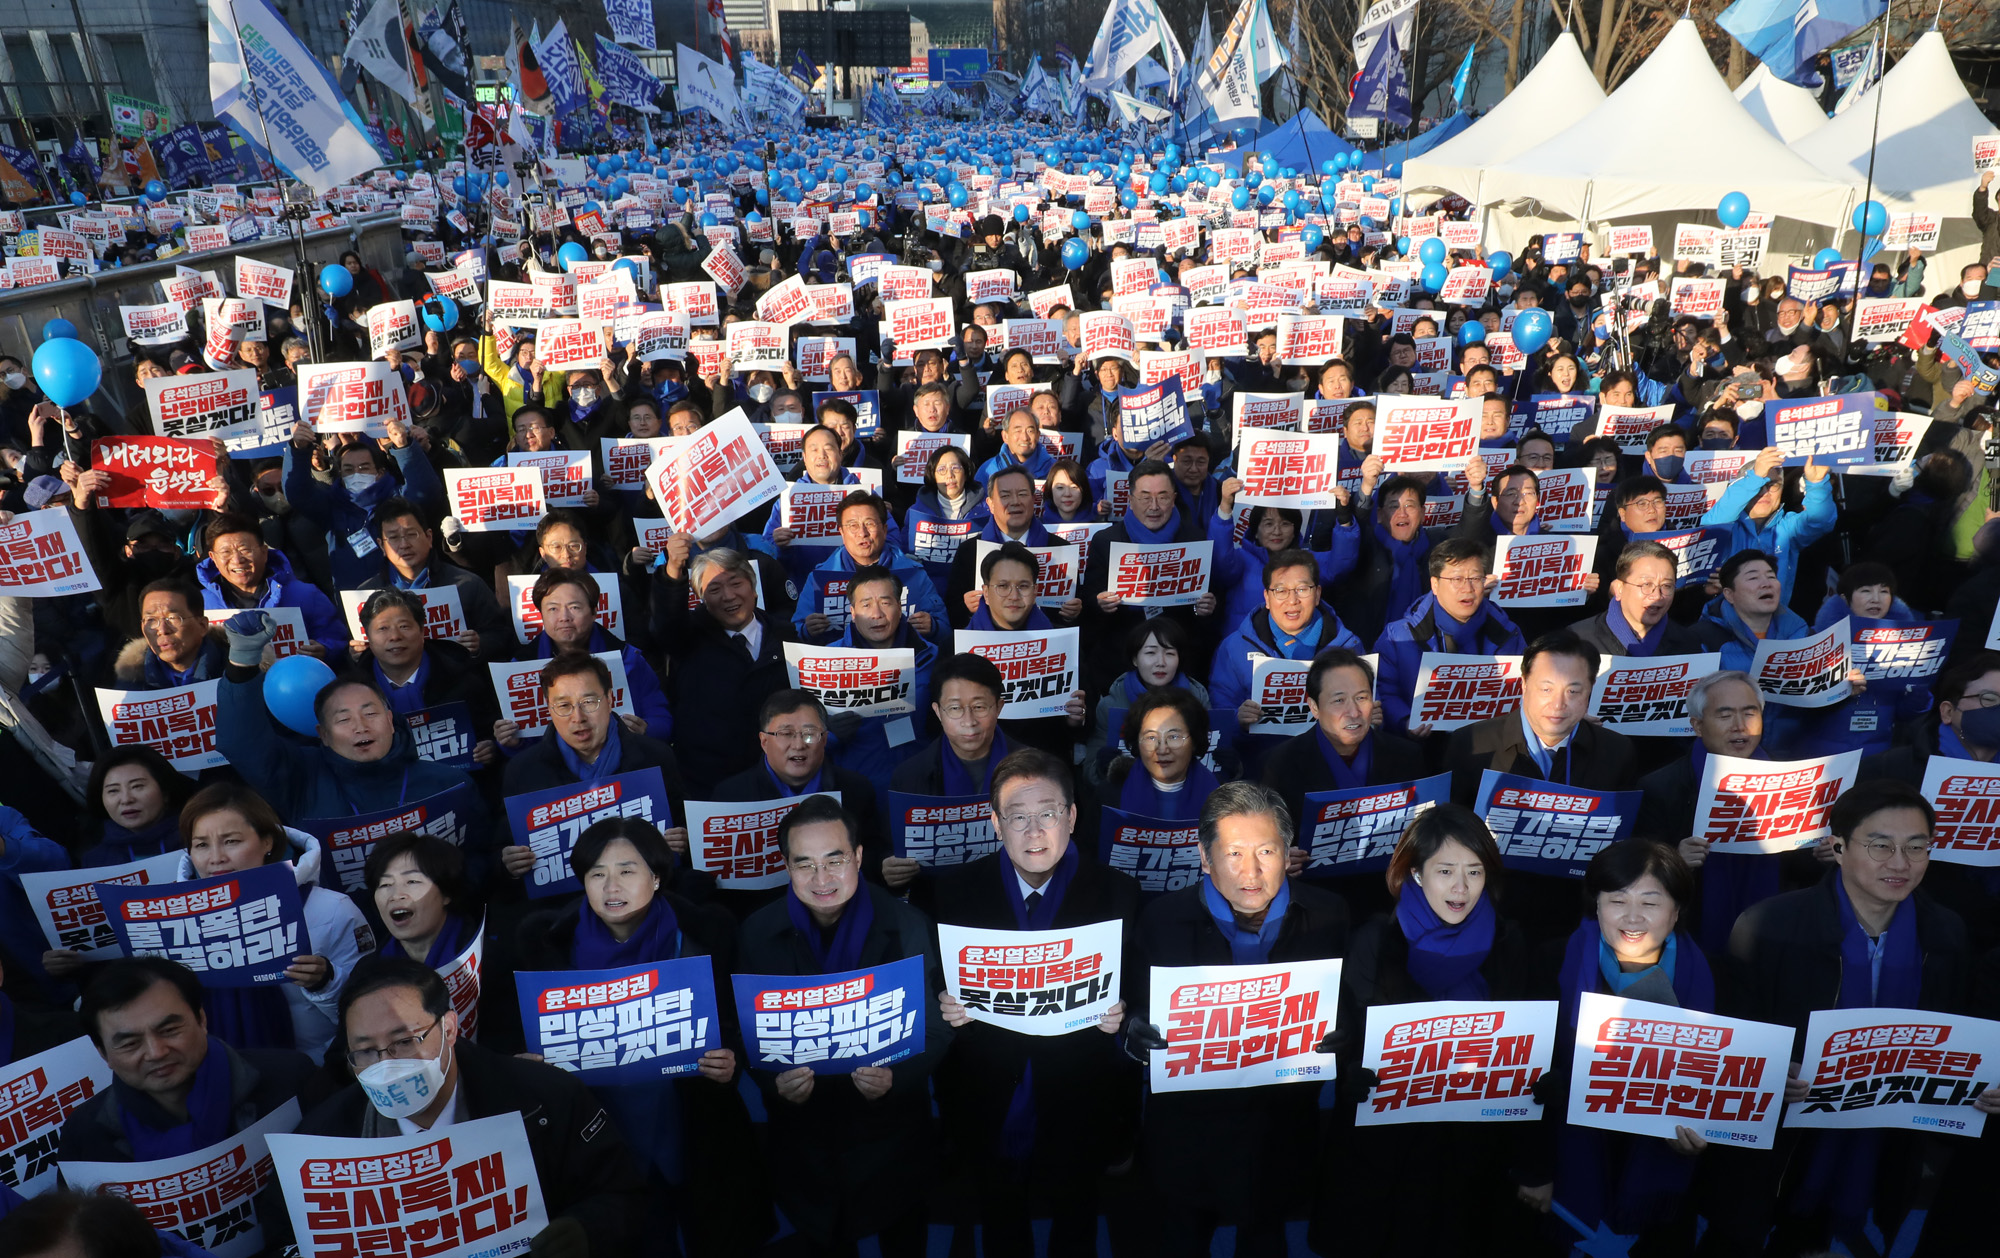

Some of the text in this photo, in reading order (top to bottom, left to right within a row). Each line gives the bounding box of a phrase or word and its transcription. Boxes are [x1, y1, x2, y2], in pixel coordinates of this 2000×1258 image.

[240, 23, 317, 102] 더불어민주당
[1837, 49, 1870, 68] 당진
[262, 98, 331, 173] 지역위원회
[1721, 236, 1762, 251] 김건희
[893, 311, 947, 333] 검사독재
[894, 323, 952, 346] 규탄한다!
[1190, 320, 1243, 338] 검사독재
[541, 331, 597, 351] 검사독재
[1008, 330, 1058, 347] 검사독재
[541, 349, 602, 366] 규탄한다!
[161, 389, 248, 420] 난방비폭탄
[163, 382, 225, 403] 윤석열정권
[307, 381, 384, 407] 검사독재
[162, 403, 257, 437] 못살겠다!
[308, 396, 390, 426] 규탄한다!
[1121, 390, 1178, 426] 물가폭탄
[1389, 408, 1453, 422] 윤석열정권
[1778, 401, 1839, 422] 윤석열정권
[1123, 405, 1186, 443] 해결하라!
[1382, 418, 1473, 444] 검사독재
[1775, 411, 1862, 443] 민생파탄
[101, 442, 199, 469] 내려와라
[1255, 441, 1304, 455] 윤석열정권
[1381, 437, 1476, 464] 규탄한다!
[655, 434, 752, 519] 검사독재
[1246, 455, 1326, 476] 검사독재
[460, 473, 512, 490] 윤석열정권
[671, 452, 771, 535] 규탄한다!
[1243, 474, 1332, 497] 규탄한다!
[457, 484, 533, 510] 검사독재
[793, 491, 844, 505] 윤석열정권
[460, 500, 542, 526] 규탄한다!
[919, 521, 968, 534] 윤석열정권
[1124, 549, 1182, 566] 윤석열정권
[1510, 543, 1564, 559] 윤석열정권
[1117, 558, 1202, 583] 검사독재
[1501, 553, 1584, 581] 검사독재
[1115, 573, 1206, 599] 규탄한다!
[1498, 572, 1587, 600] 규탄한다!
[1858, 626, 1930, 643] 윤석열정권
[803, 656, 872, 671] 윤석열정권
[973, 643, 1043, 661] 윤석열정권
[1760, 641, 1845, 680] 난방비폭탄
[1771, 637, 1834, 664] 윤석열정권
[1850, 638, 1947, 663] 물가폭탄
[798, 669, 901, 689] 난방비폭탄
[1435, 664, 1505, 679] 윤석열정권
[1613, 667, 1683, 684] 윤석열정권
[1757, 655, 1850, 696] 못살겠다!
[114, 694, 193, 721] 윤석열정권
[1724, 768, 1819, 793] 윤석열정권
[531, 784, 617, 828] 윤석열정권
[1323, 790, 1410, 821] 윤석열정권
[1499, 788, 1594, 813] 윤석열정권
[1708, 776, 1844, 819] 검사독재
[909, 801, 993, 823] 윤석열정권
[1486, 806, 1624, 840] 물가폭탄
[1702, 803, 1834, 844] 규탄한다
[331, 810, 423, 847] 윤석열정권
[1120, 826, 1200, 846] 윤석열정권
[127, 884, 233, 919] 윤석열정권
[126, 896, 282, 945] 물가폭탄
[965, 943, 1066, 965] 윤석열정권
[958, 952, 1105, 990] 난방비폭탄
[545, 974, 650, 1010] 윤석열정권
[762, 977, 866, 1010] 윤석열정권
[959, 971, 1114, 1018] 못살겠다!
[1177, 976, 1283, 1009] 윤석열정권
[539, 986, 694, 1046] 민생파탄
[755, 986, 906, 1040] 민생파탄
[1165, 990, 1321, 1043] 검사독재
[758, 1009, 918, 1064] 못살겠다!
[1391, 1012, 1496, 1046] 윤석열정권
[1605, 1018, 1723, 1051] 윤석열정권
[1829, 1023, 1944, 1055] 윤석열정권
[543, 1016, 709, 1072] 못살겠다!
[1164, 1021, 1330, 1078] 규탄한다!
[1275, 1065, 1321, 1079] 더불어민주당
[1376, 1034, 1536, 1083] 검사독재
[1588, 1044, 1768, 1089] 검사독재
[1811, 1048, 1983, 1086] 난방비폭탄
[1371, 1066, 1543, 1114] 규탄한다!
[1584, 1078, 1775, 1122] 규탄한다!
[1798, 1074, 1990, 1115] 못살겠다!
[1480, 1107, 1529, 1118] 더불어민주당
[1911, 1114, 1966, 1131] 더불어민주당
[1704, 1128, 1759, 1144] 더불어민주당
[308, 1144, 442, 1186] 윤석열정권
[303, 1151, 507, 1231] 검사독재
